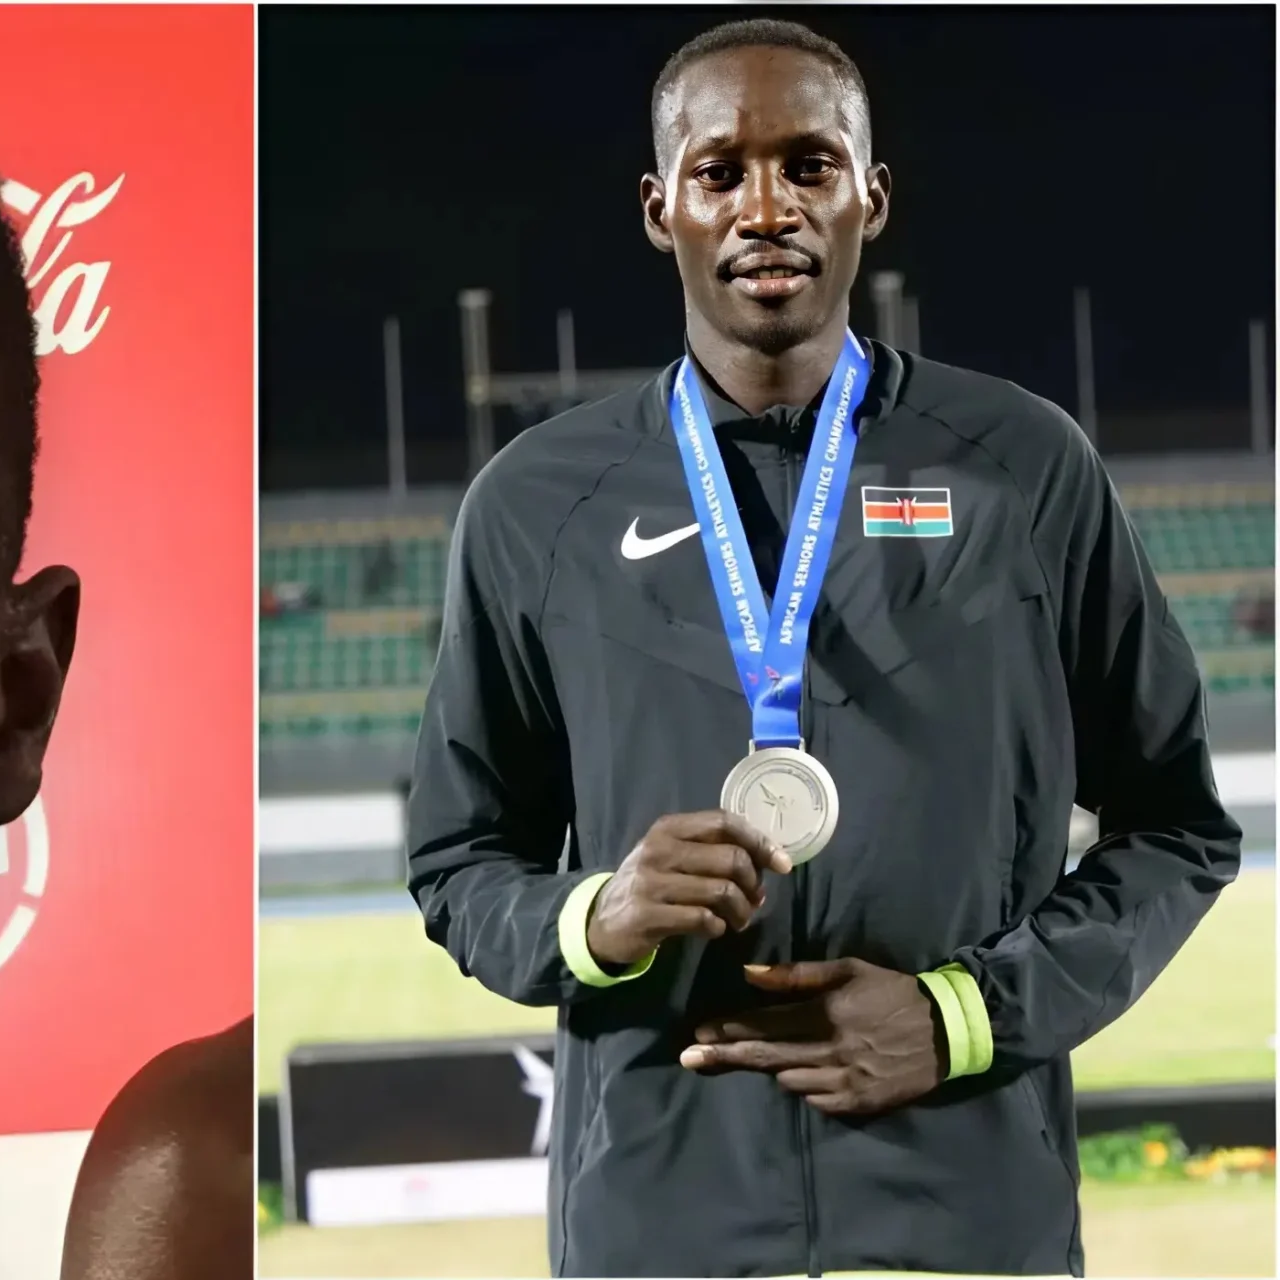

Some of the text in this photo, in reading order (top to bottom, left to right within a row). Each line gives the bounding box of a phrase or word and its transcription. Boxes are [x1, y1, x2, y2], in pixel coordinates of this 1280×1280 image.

[701, 472, 729, 539] ATHLETICS
[779, 365, 858, 645] AFRICAN SENIORS ATHLETICS CHAMPIONSHIPS
[720, 541, 746, 596] SENIORS
[735, 598, 763, 653] AFRICAN
